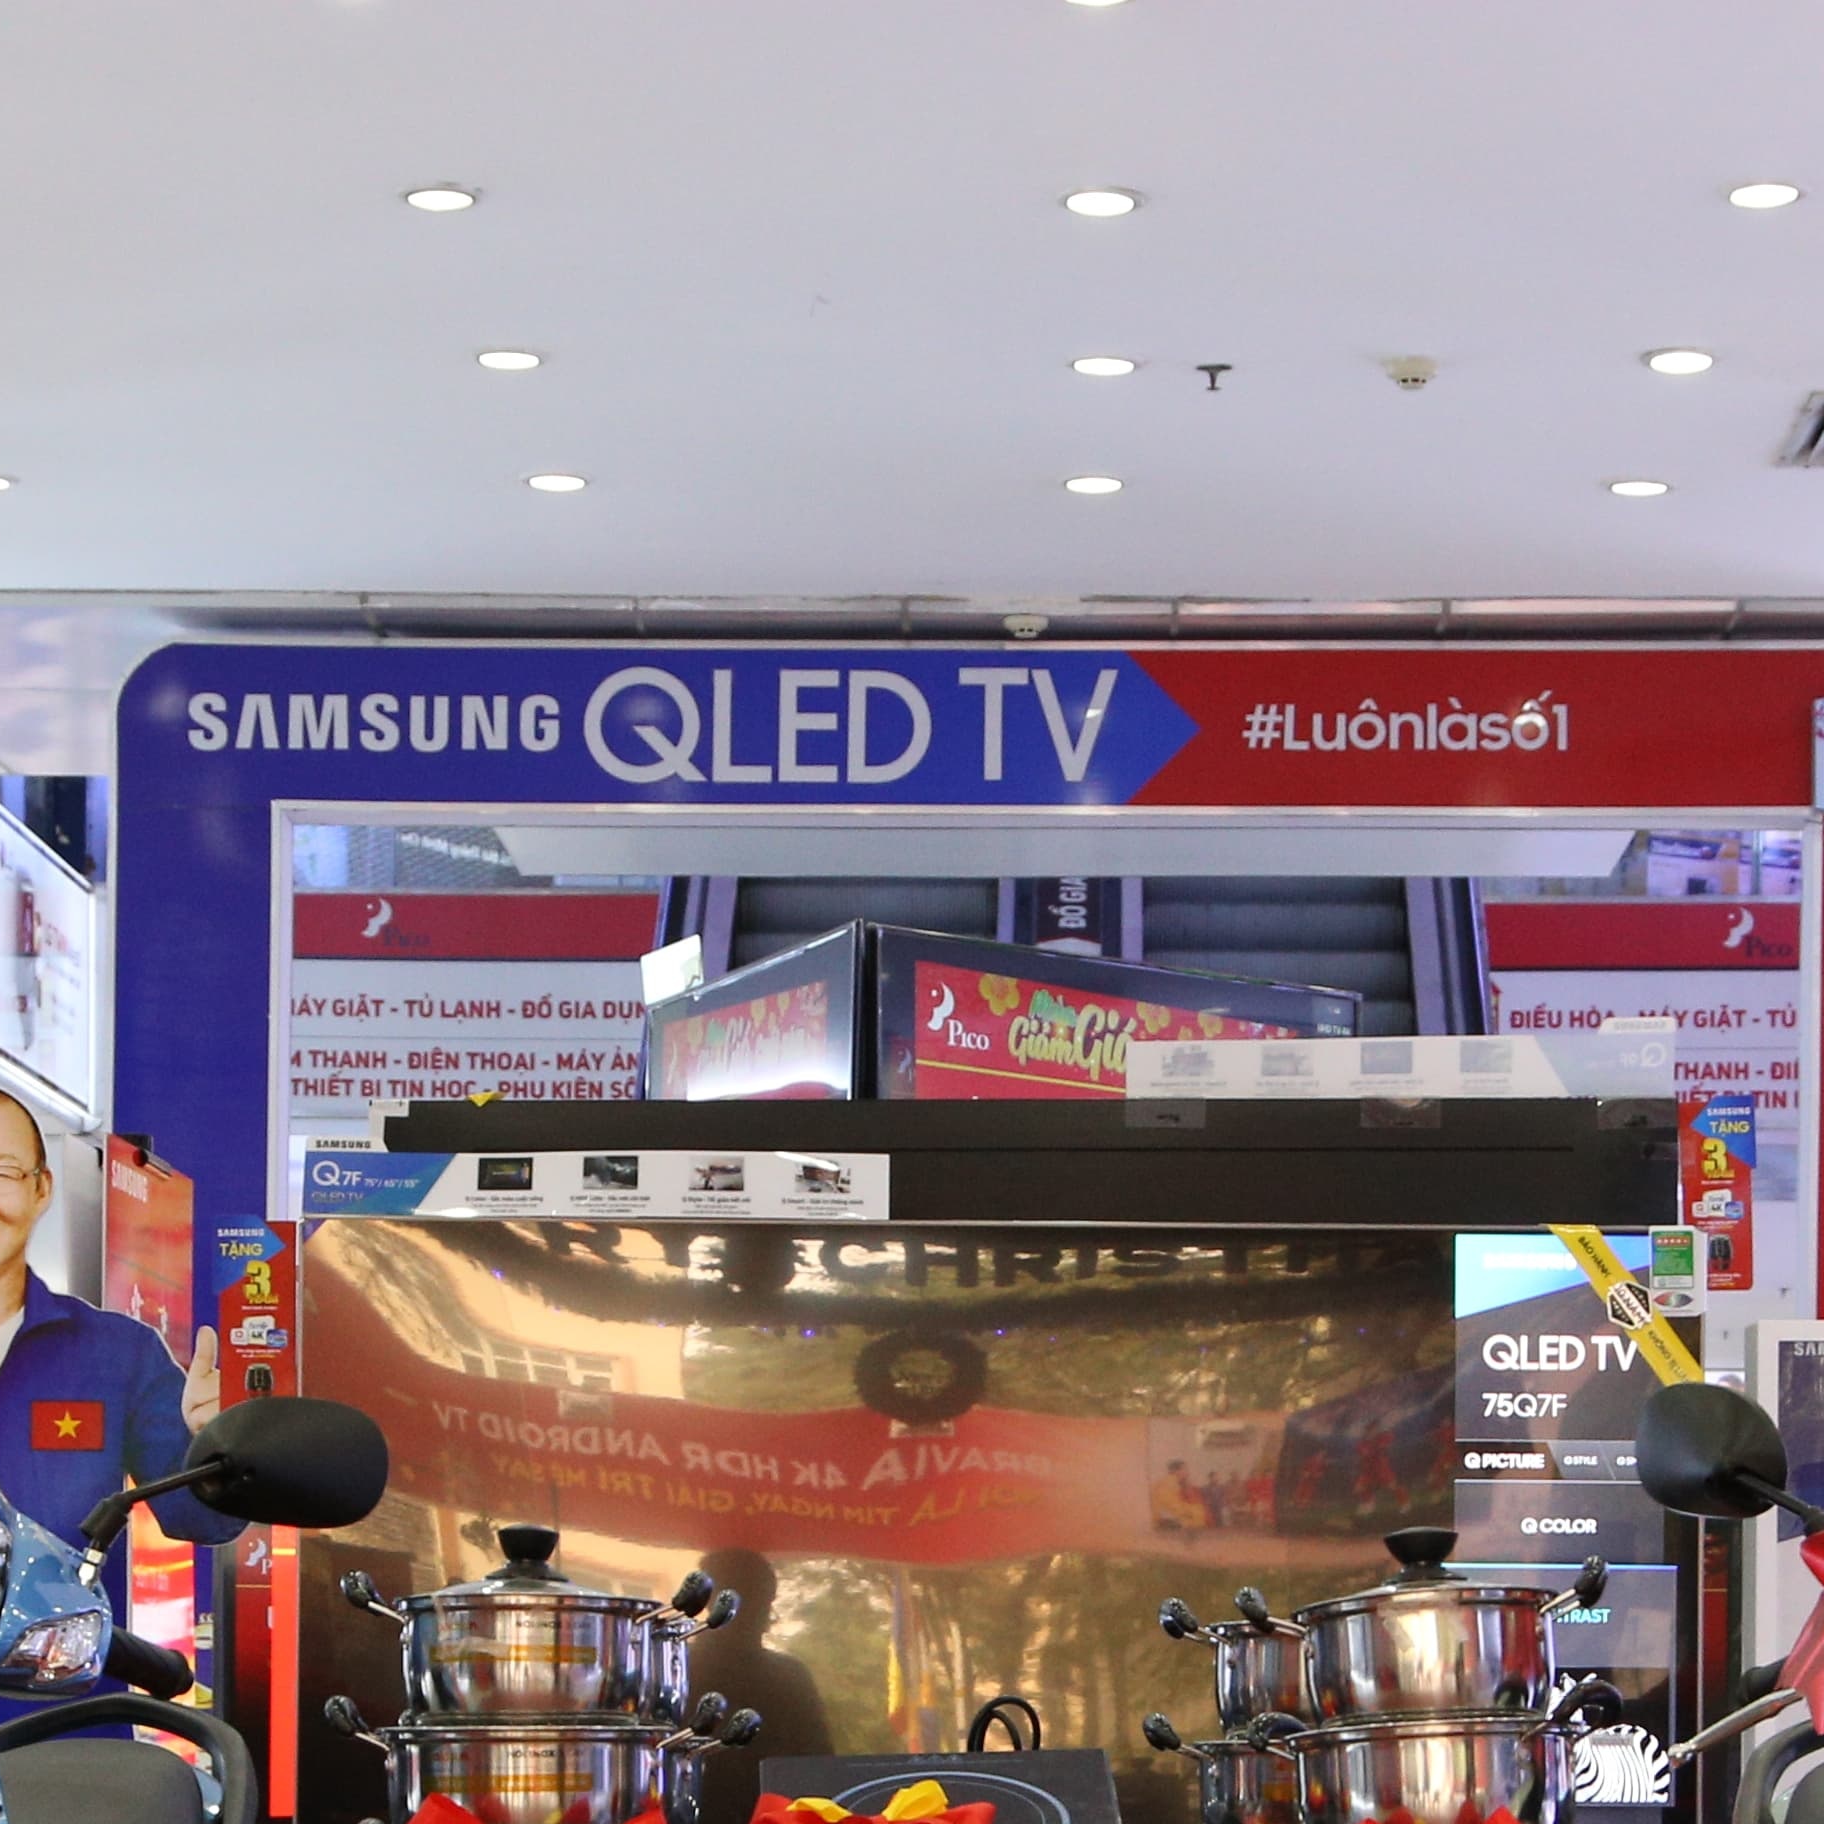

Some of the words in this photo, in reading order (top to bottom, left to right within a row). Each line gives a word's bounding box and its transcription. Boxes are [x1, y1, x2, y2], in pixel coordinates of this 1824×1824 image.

[187, 691, 562, 754] SAMSUNG
[584, 666, 933, 784] QLED
[957, 667, 1119, 782] TV
[1242, 689, 1570, 754] #Luônlàsố1
[1744, 934, 1794, 960] Pico
[332, 996, 385, 1025] GIẶT
[403, 992, 436, 1019] TỦ
[440, 1000, 502, 1025] LẠNH
[521, 992, 553, 1019] ĐỒ
[558, 1000, 596, 1020] GIA
[1509, 1003, 1563, 1029] ĐIỀU
[1693, 1008, 1748, 1036] GIẶT
[1766, 1002, 1798, 1029] TỦ
[947, 1020, 990, 1050] Pico
[308, 1049, 388, 1070] THANH
[407, 1046, 459, 1076] ĐIỆN
[465, 1051, 537, 1077] THOẠI
[556, 1046, 606, 1072] MÁY
[1673, 1060, 1750, 1081] THANH
[290, 1072, 355, 1097] THIẾT
[388, 1080, 427, 1098] TIN
[1707, 1107, 1751, 1117] SAMSUNG
[1709, 1120, 1751, 1138] TẶNG
[315, 1138, 372, 1150] SAMSUNG
[1701, 1136, 1728, 1175] 3
[312, 1160, 364, 1187] Q7F
[217, 1228, 265, 1238] SAMSUNG
[219, 1242, 264, 1260] TẶNG
[242, 1259, 273, 1300] 3
[1482, 1333, 1586, 1372] QLED
[1590, 1334, 1638, 1372] TV
[1481, 1392, 1569, 1418] 75Q7F
[1482, 1452, 1546, 1470] PICTURE
[1539, 1516, 1598, 1535] COLOR
